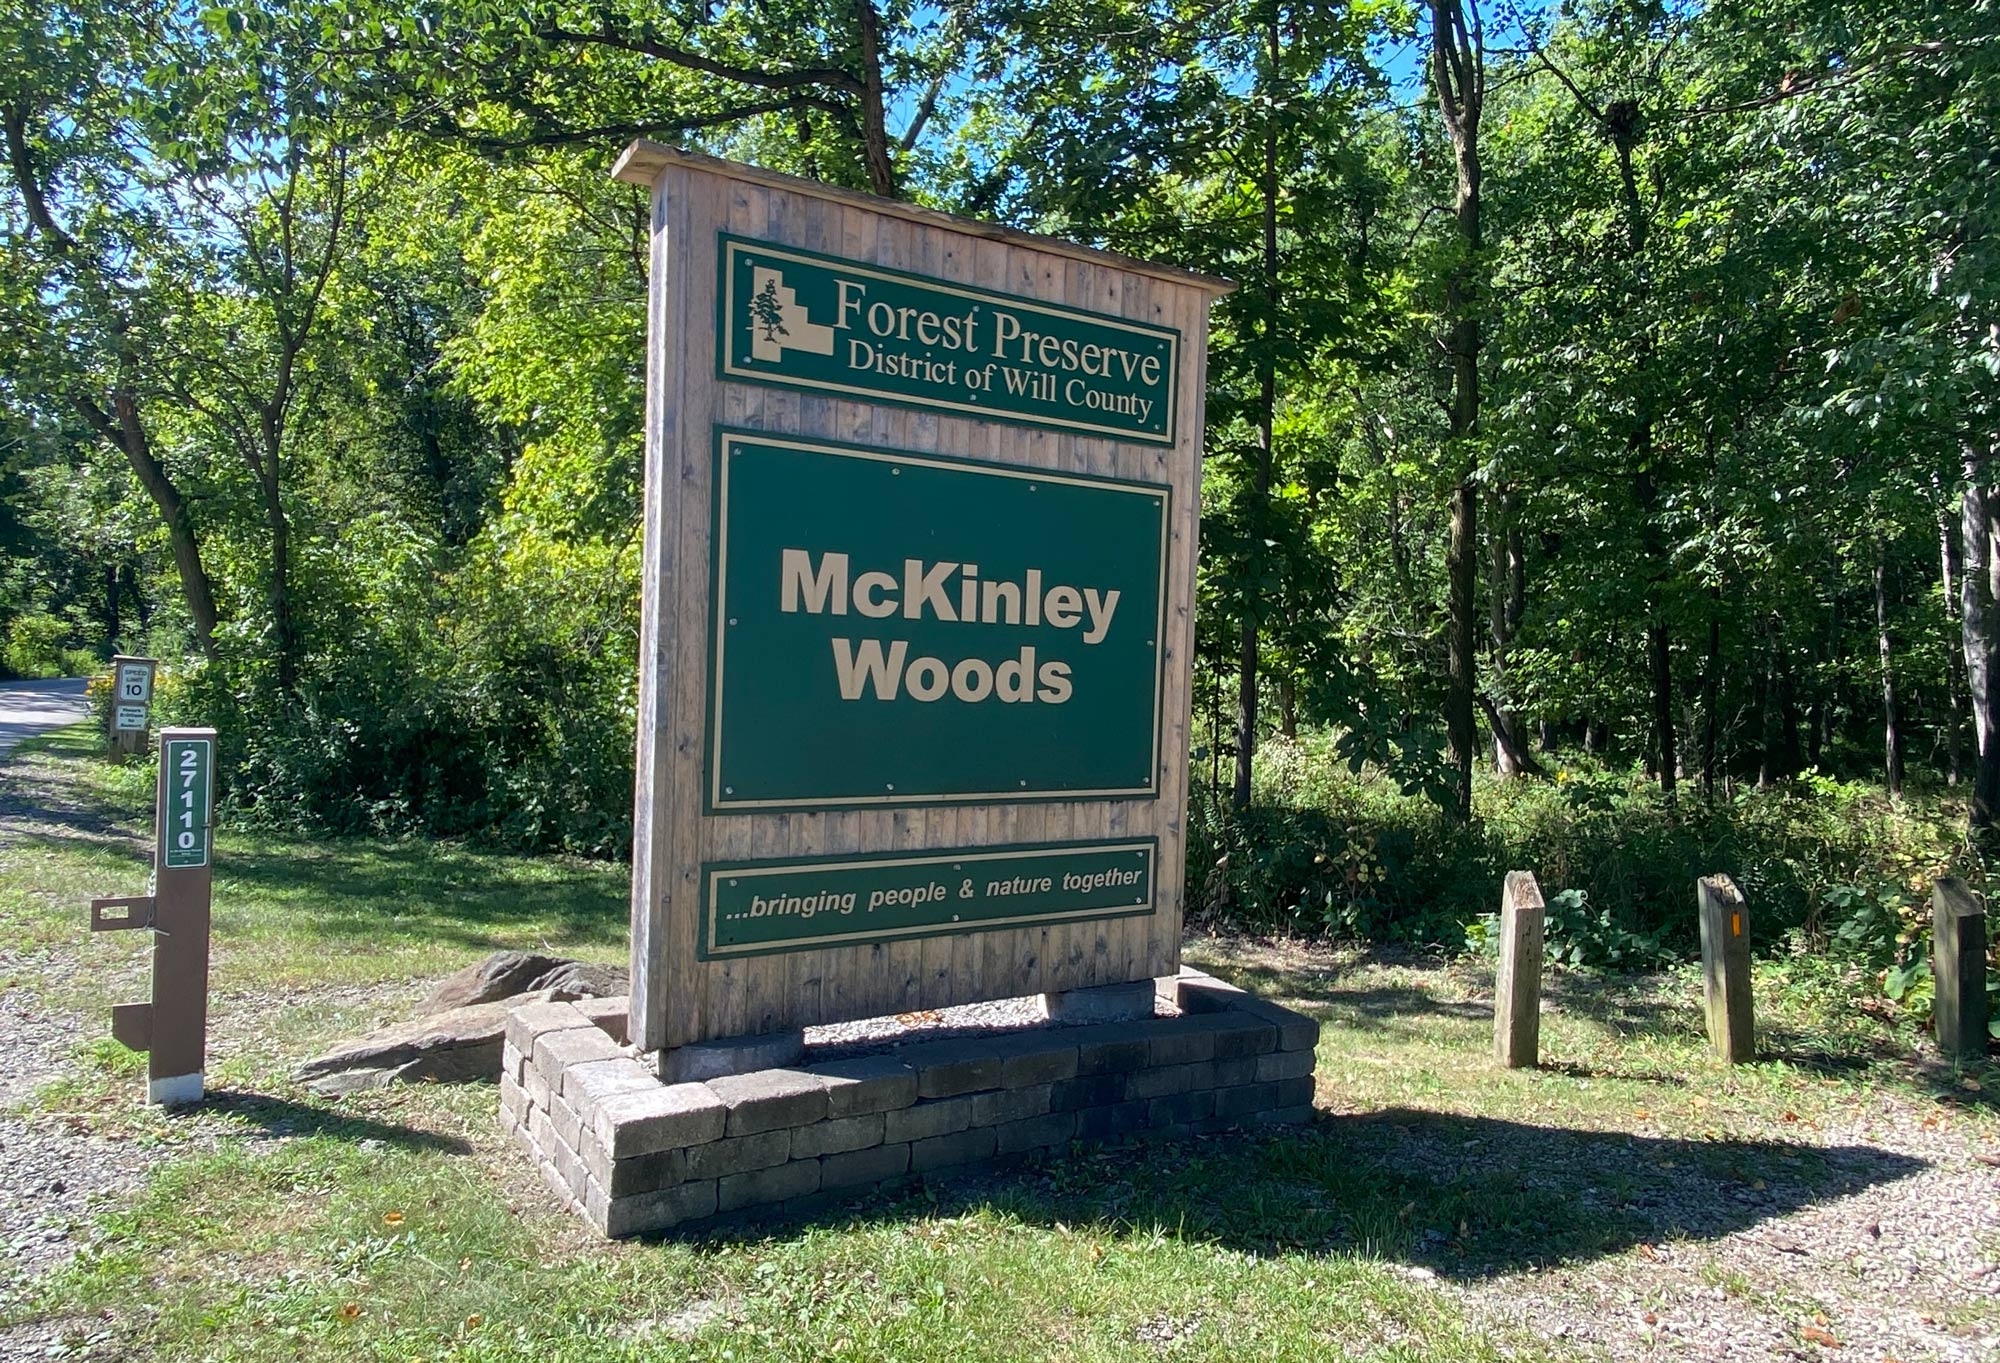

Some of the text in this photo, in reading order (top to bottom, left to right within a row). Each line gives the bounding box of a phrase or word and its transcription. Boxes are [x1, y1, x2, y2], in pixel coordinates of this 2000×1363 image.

[832, 279, 1161, 385] Forest Preserve
[848, 338, 1154, 424] District of Will County
[781, 548, 1121, 645] McKinley
[126, 684, 142, 696] 10
[831, 637, 1073, 704] Woods
[868, 881, 947, 912] people
[959, 878, 974, 899] &
[986, 876, 1052, 897] nature
[1062, 868, 1142, 893] together
